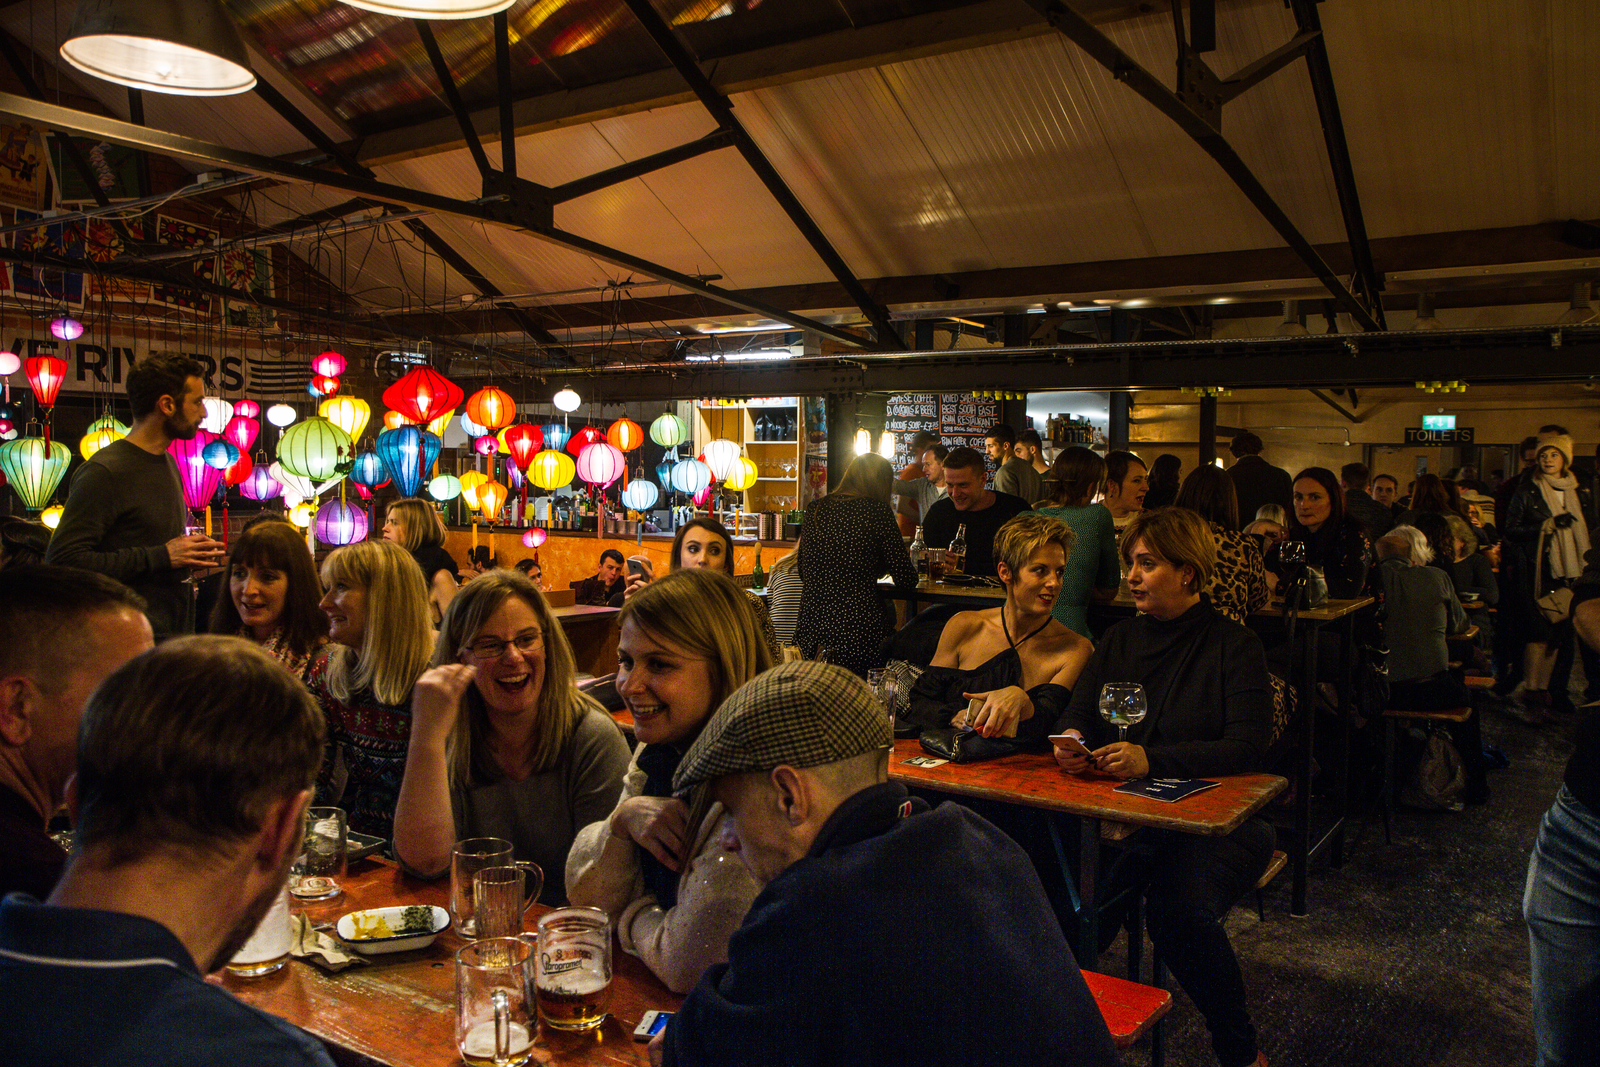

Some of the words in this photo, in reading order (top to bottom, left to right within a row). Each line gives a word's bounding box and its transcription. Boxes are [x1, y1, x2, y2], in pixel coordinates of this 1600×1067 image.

[941, 404, 957, 414] BEST
[977, 405, 997, 418] EAST
[1407, 429, 1471, 442] TOILETS
